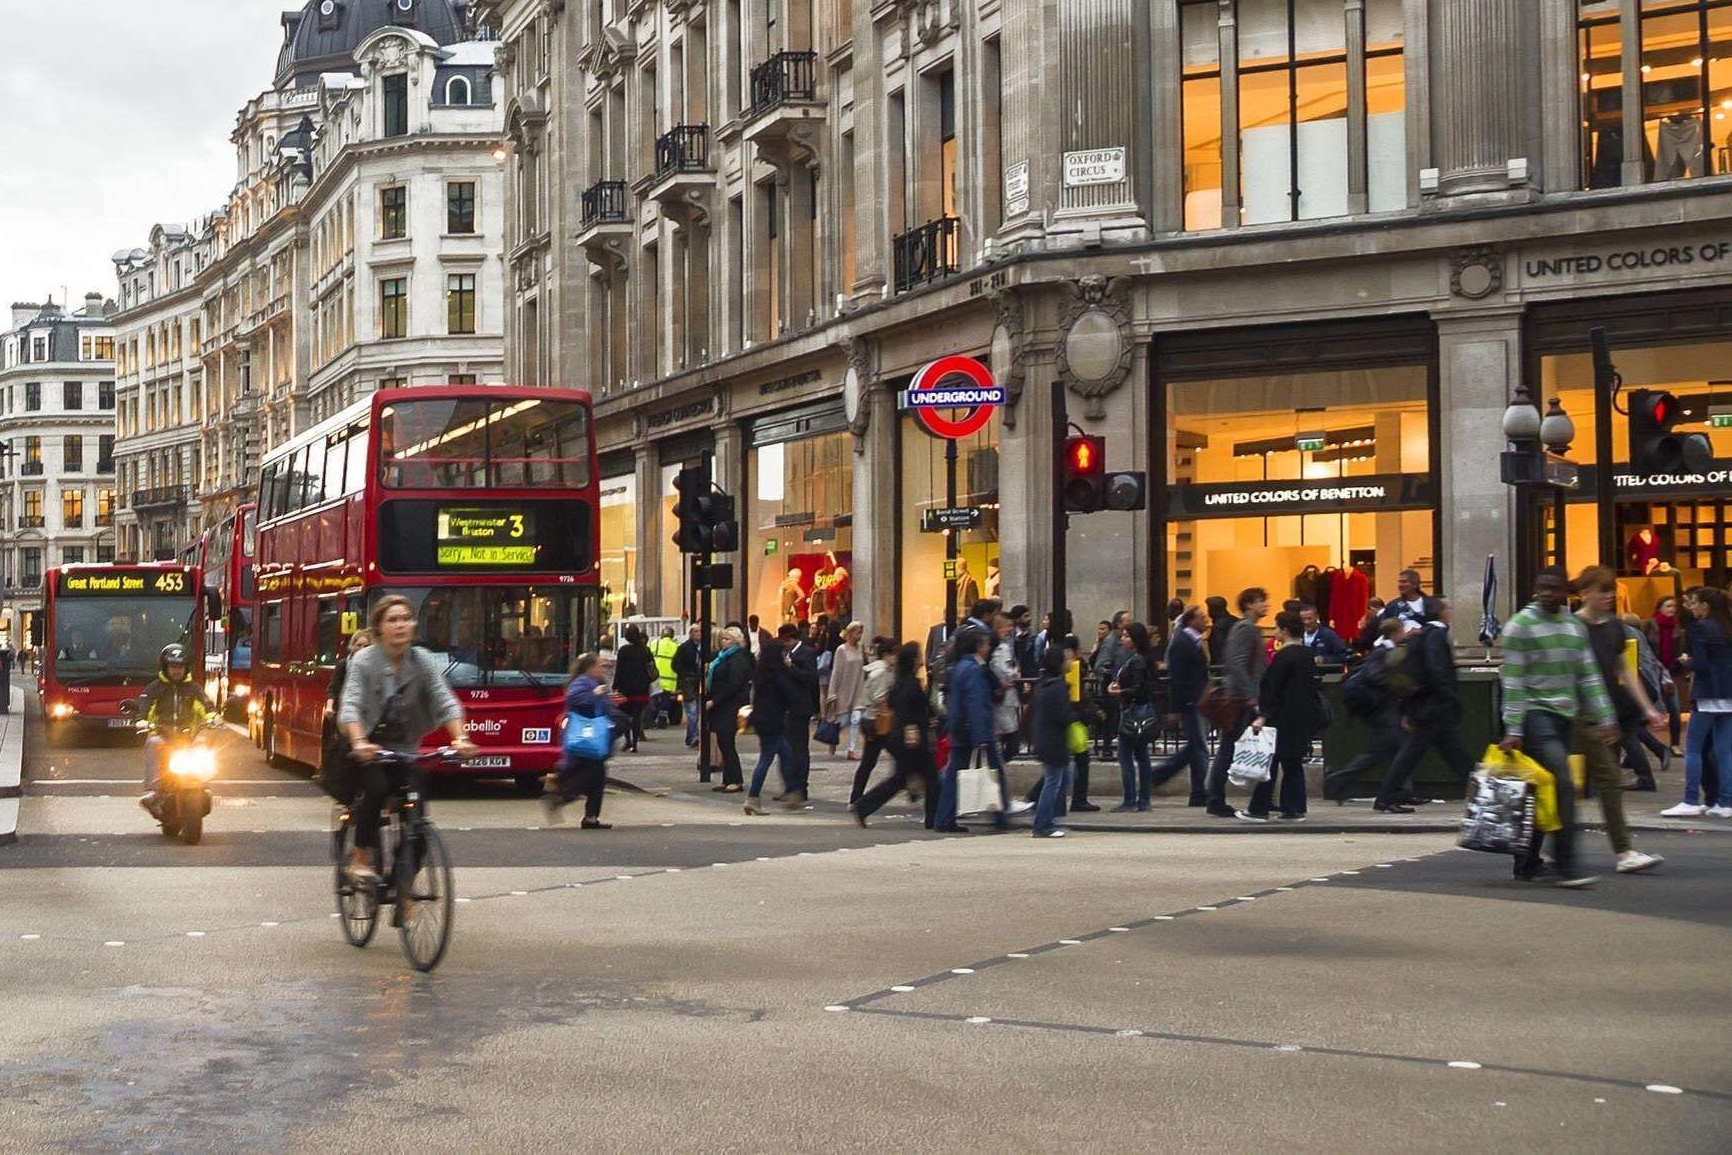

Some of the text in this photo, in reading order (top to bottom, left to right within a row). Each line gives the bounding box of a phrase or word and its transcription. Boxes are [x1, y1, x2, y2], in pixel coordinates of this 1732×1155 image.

[1069, 153, 1111, 165] OXFORD
[1069, 166, 1106, 177] CIRCUS
[1526, 243, 1730, 277] UNITED COLORS OF
[911, 390, 1001, 404] UNDERGROUND
[1707, 471, 1727, 483] OF
[1205, 487, 1384, 505] UNITED COLORS OF BENETTON
[450, 514, 524, 538] Westminster 3
[471, 547, 485, 559] Not
[491, 550, 498, 559] in
[68, 573, 184, 591] Great Portland Street 453
[470, 690, 489, 698] 9726
[463, 719, 501, 731] abellio
